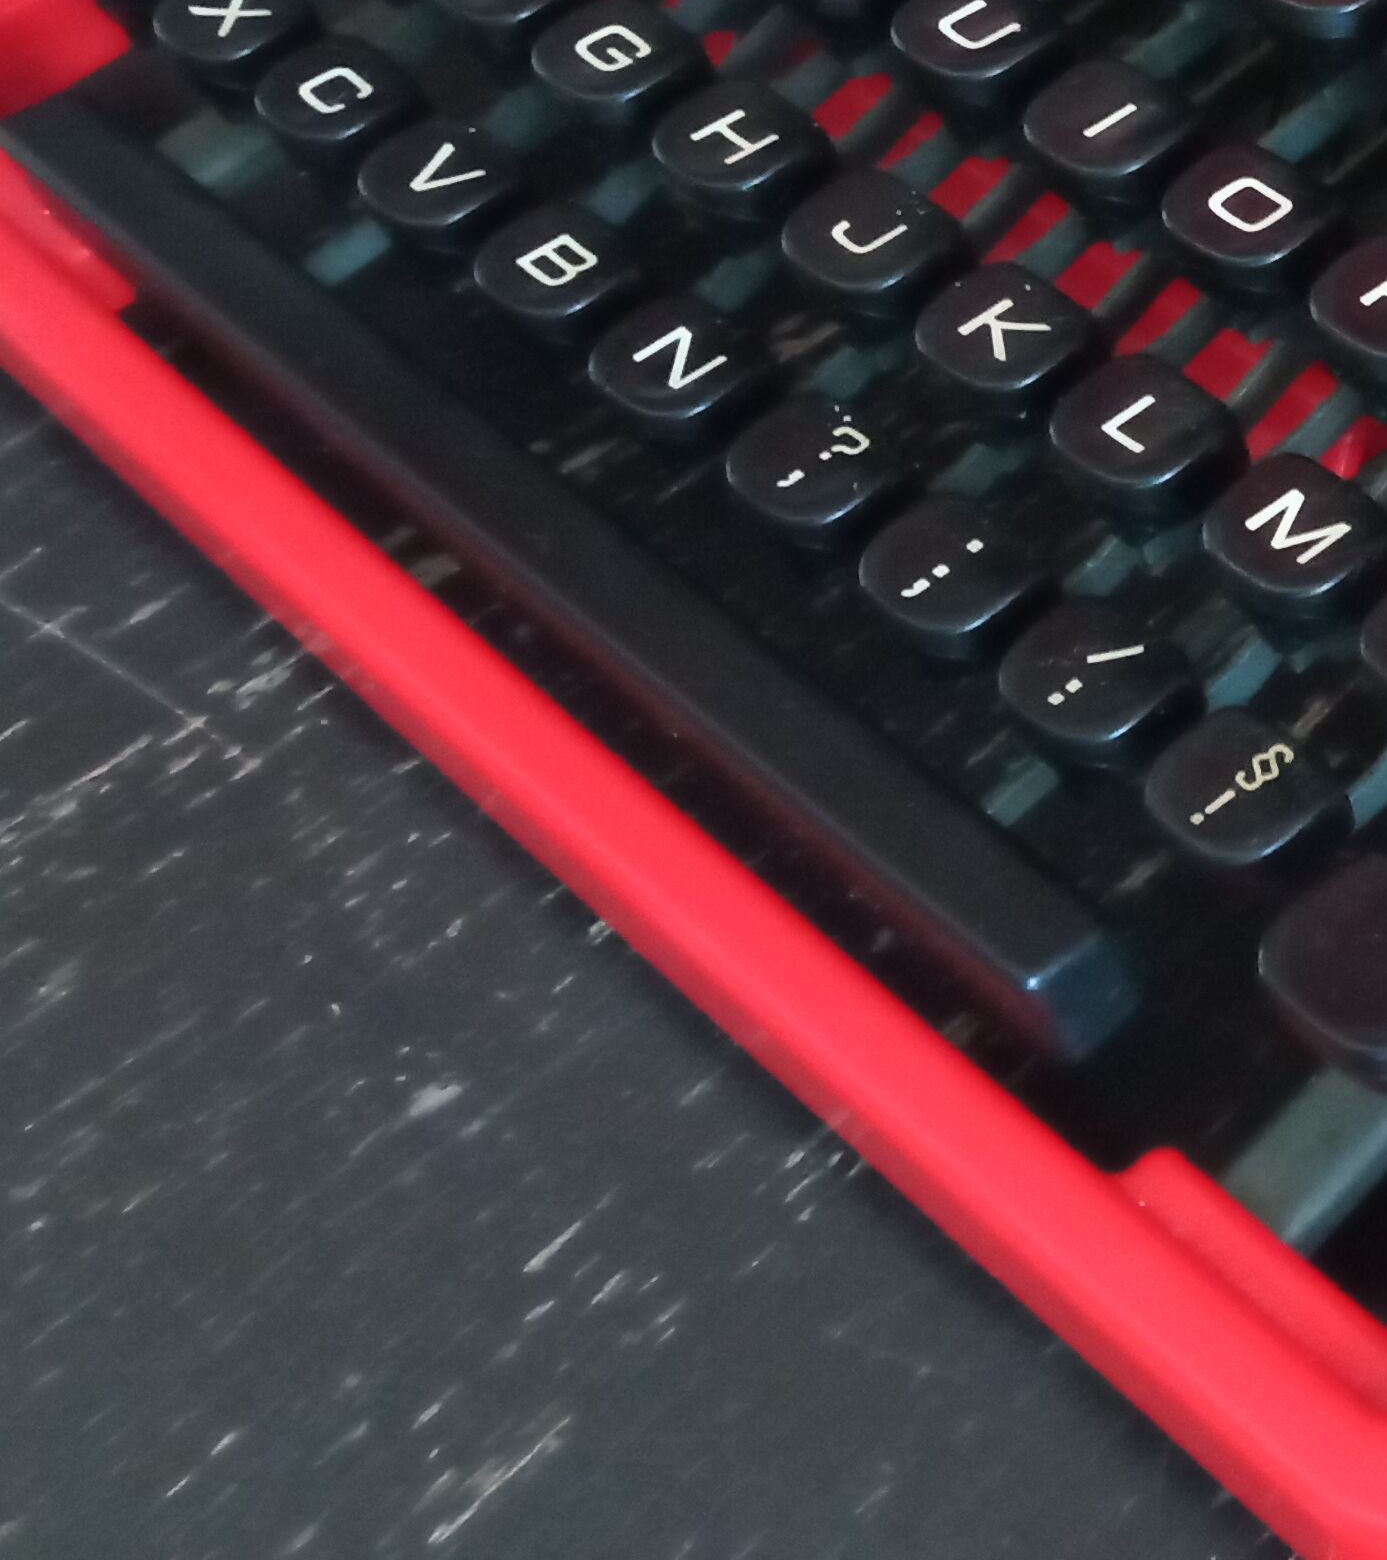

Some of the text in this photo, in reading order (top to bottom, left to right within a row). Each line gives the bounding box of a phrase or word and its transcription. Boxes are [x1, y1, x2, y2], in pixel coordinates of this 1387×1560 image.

[574, 24, 652, 72] G
[298, 67, 373, 114] C
[690, 109, 780, 165] H
[1082, 103, 1138, 138] I
[409, 142, 486, 192] V
[1207, 177, 1294, 233] O
[515, 234, 598, 287] B
[831, 220, 908, 254] J
[957, 298, 1052, 362] K
[632, 325, 728, 390] N
[818, 426, 870, 461] ?
[1100, 394, 1156, 454] L
[1244, 488, 1352, 565] M
[1086, 644, 1145, 664] /
[1234, 743, 1295, 791] §
